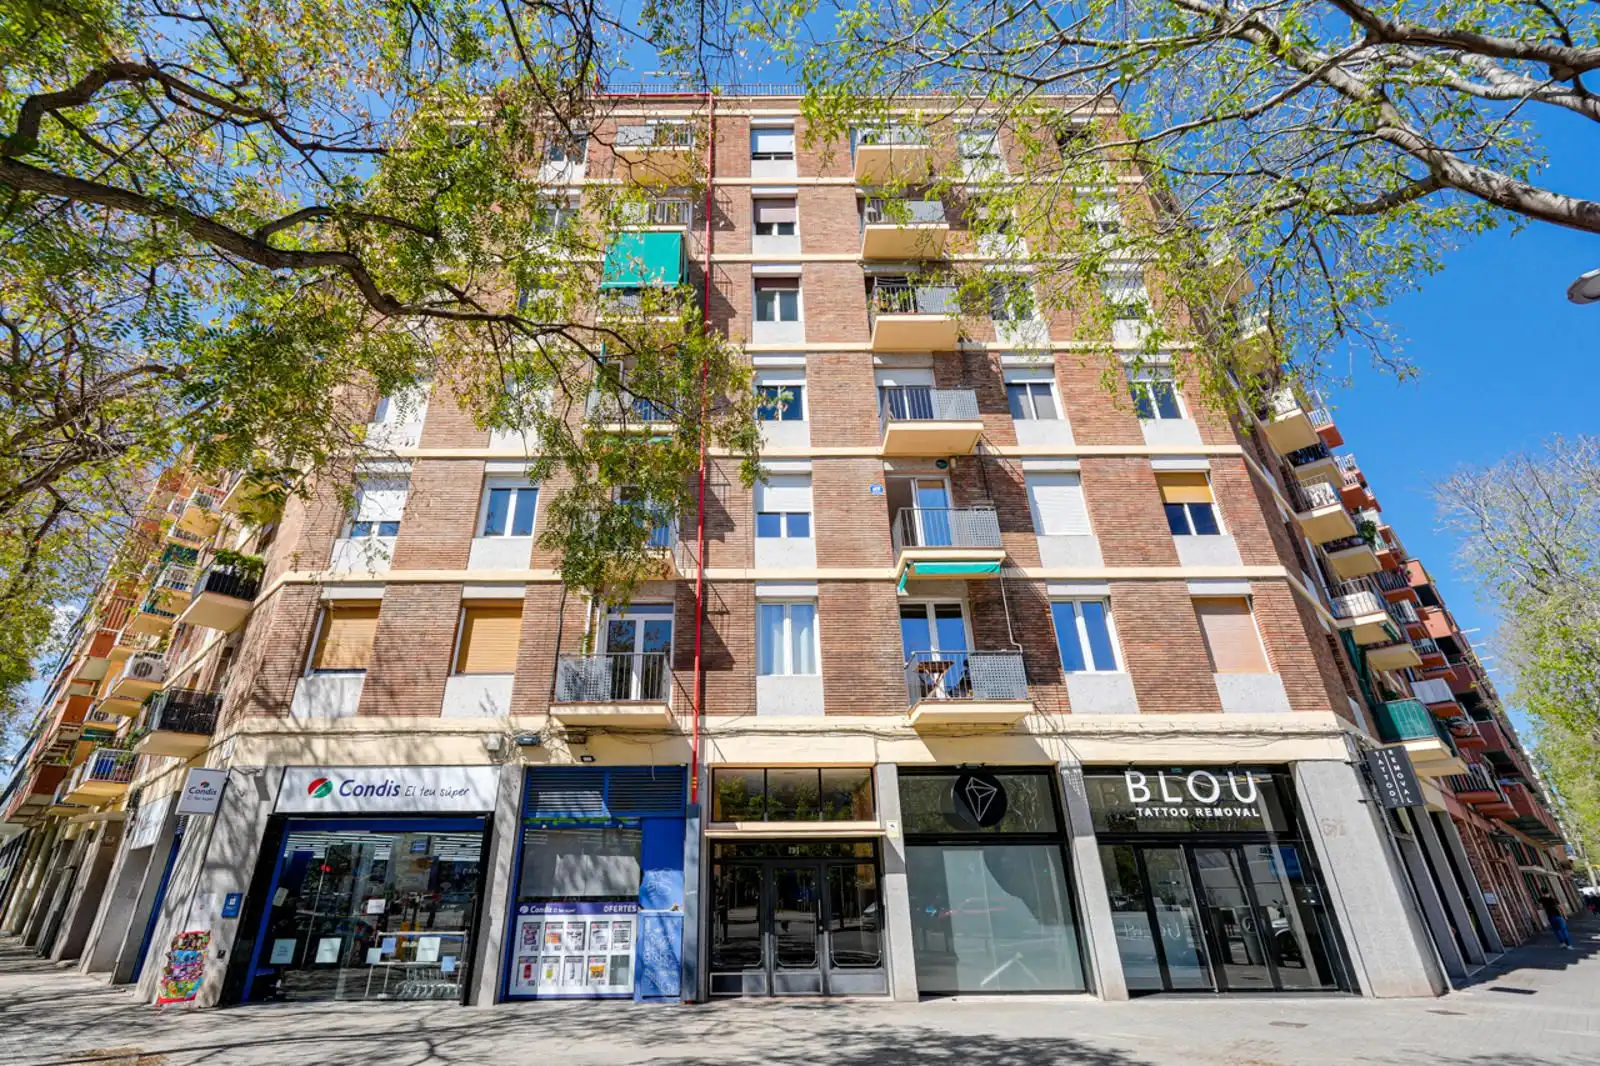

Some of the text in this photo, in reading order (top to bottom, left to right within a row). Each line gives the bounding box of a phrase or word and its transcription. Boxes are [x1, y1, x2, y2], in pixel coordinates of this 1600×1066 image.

[1124, 770, 1258, 804] BLOU
[1374, 751, 1397, 797] TATTOO
[1387, 749, 1413, 804] REMOVAL
[339, 779, 470, 799] Condis El teu súper
[1136, 807, 1260, 817] TATTOO REMOVAL
[603, 904, 638, 914] OFERTES
